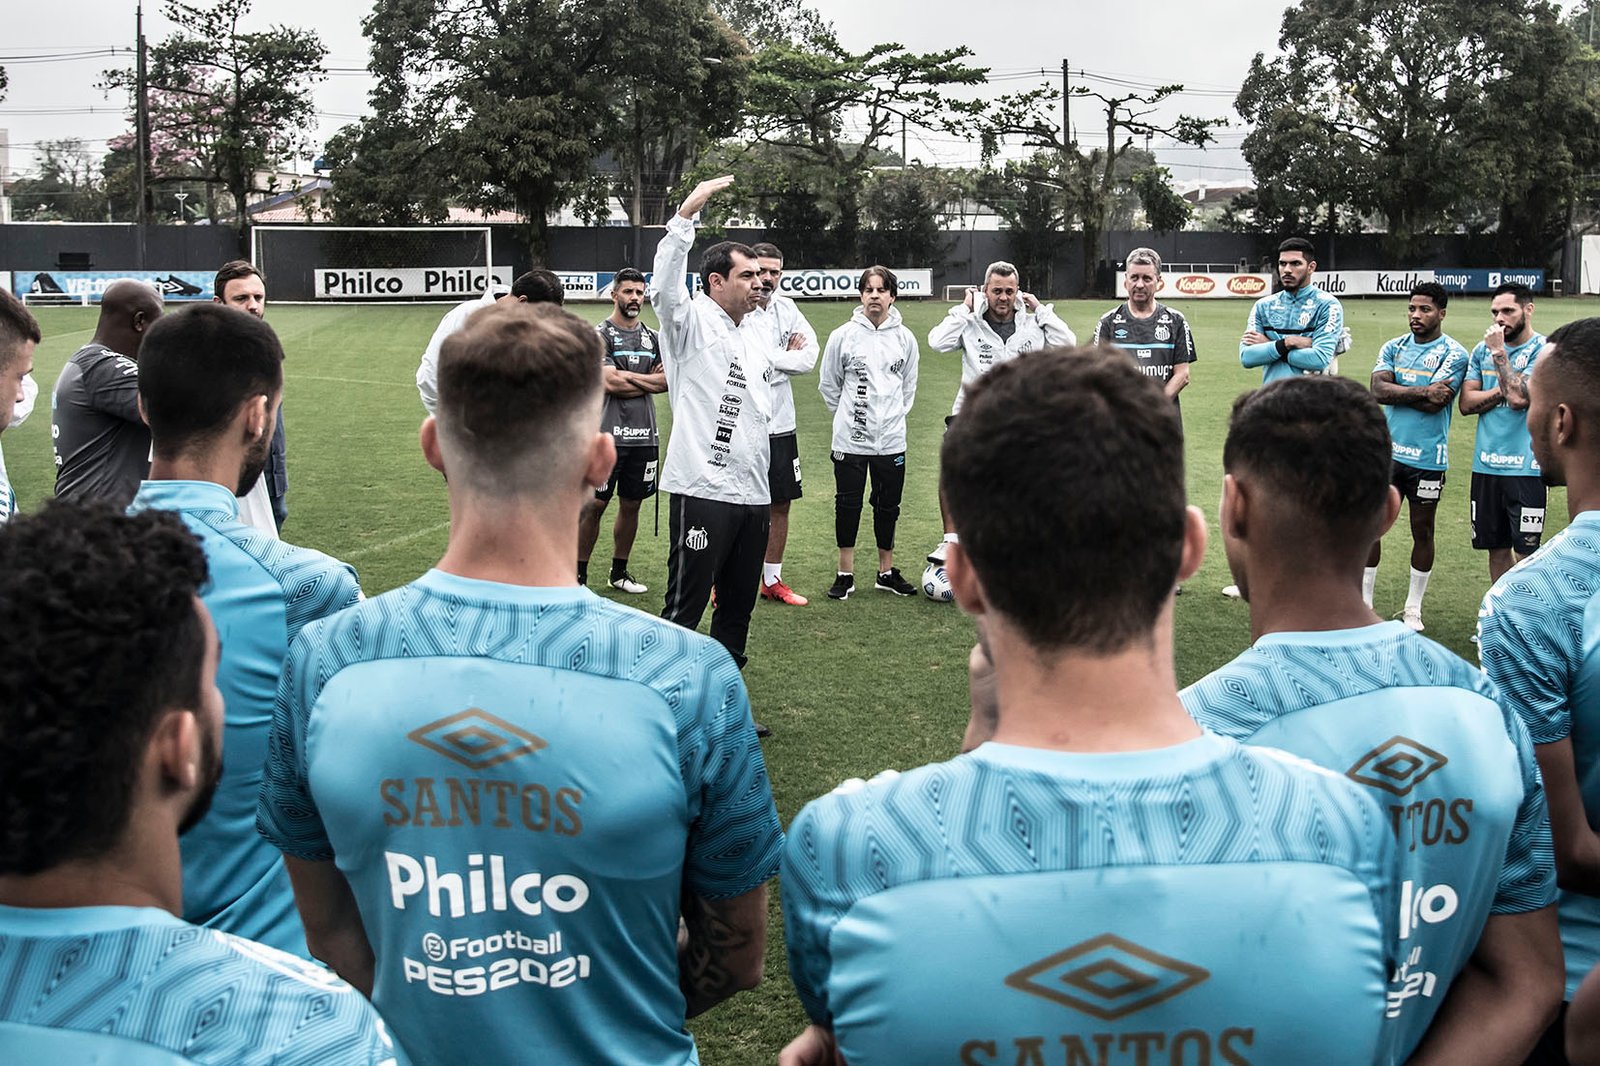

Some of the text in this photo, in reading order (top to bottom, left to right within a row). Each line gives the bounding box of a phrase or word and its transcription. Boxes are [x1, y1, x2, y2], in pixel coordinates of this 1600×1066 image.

[324, 271, 403, 294] Philco
[780, 270, 851, 296] ceano
[1177, 278, 1214, 291] Kodilar
[1228, 278, 1265, 291] Kodilar
[613, 426, 651, 436] BrSUPPLY
[711, 444, 730, 453] TODOS
[1391, 442, 1422, 457] SUPPLY
[1480, 451, 1524, 465] BrSUPPLY
[1522, 516, 1543, 524] STX
[380, 777, 583, 837] SANTOS
[384, 851, 590, 918] Philco
[403, 955, 591, 997] PES2021
